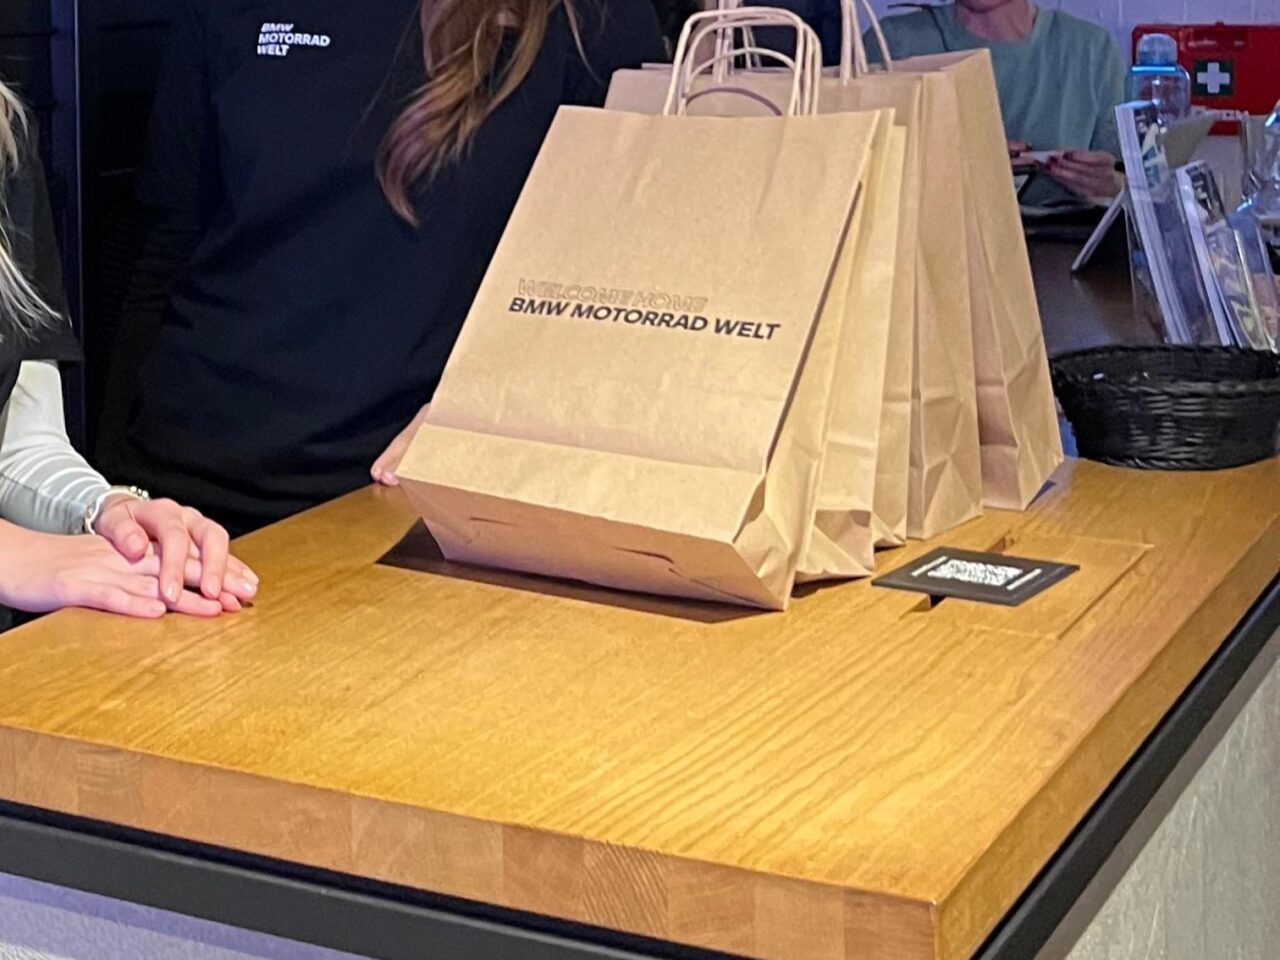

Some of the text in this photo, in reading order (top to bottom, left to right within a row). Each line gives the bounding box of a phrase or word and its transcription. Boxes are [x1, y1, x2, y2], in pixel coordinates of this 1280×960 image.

[261, 23, 294, 32] BMW
[258, 33, 331, 47] MOTORRAD
[257, 45, 289, 56] WELT
[518, 278, 634, 306] WELCOME
[508, 297, 780, 340] BMW MOTORRAD WELT
